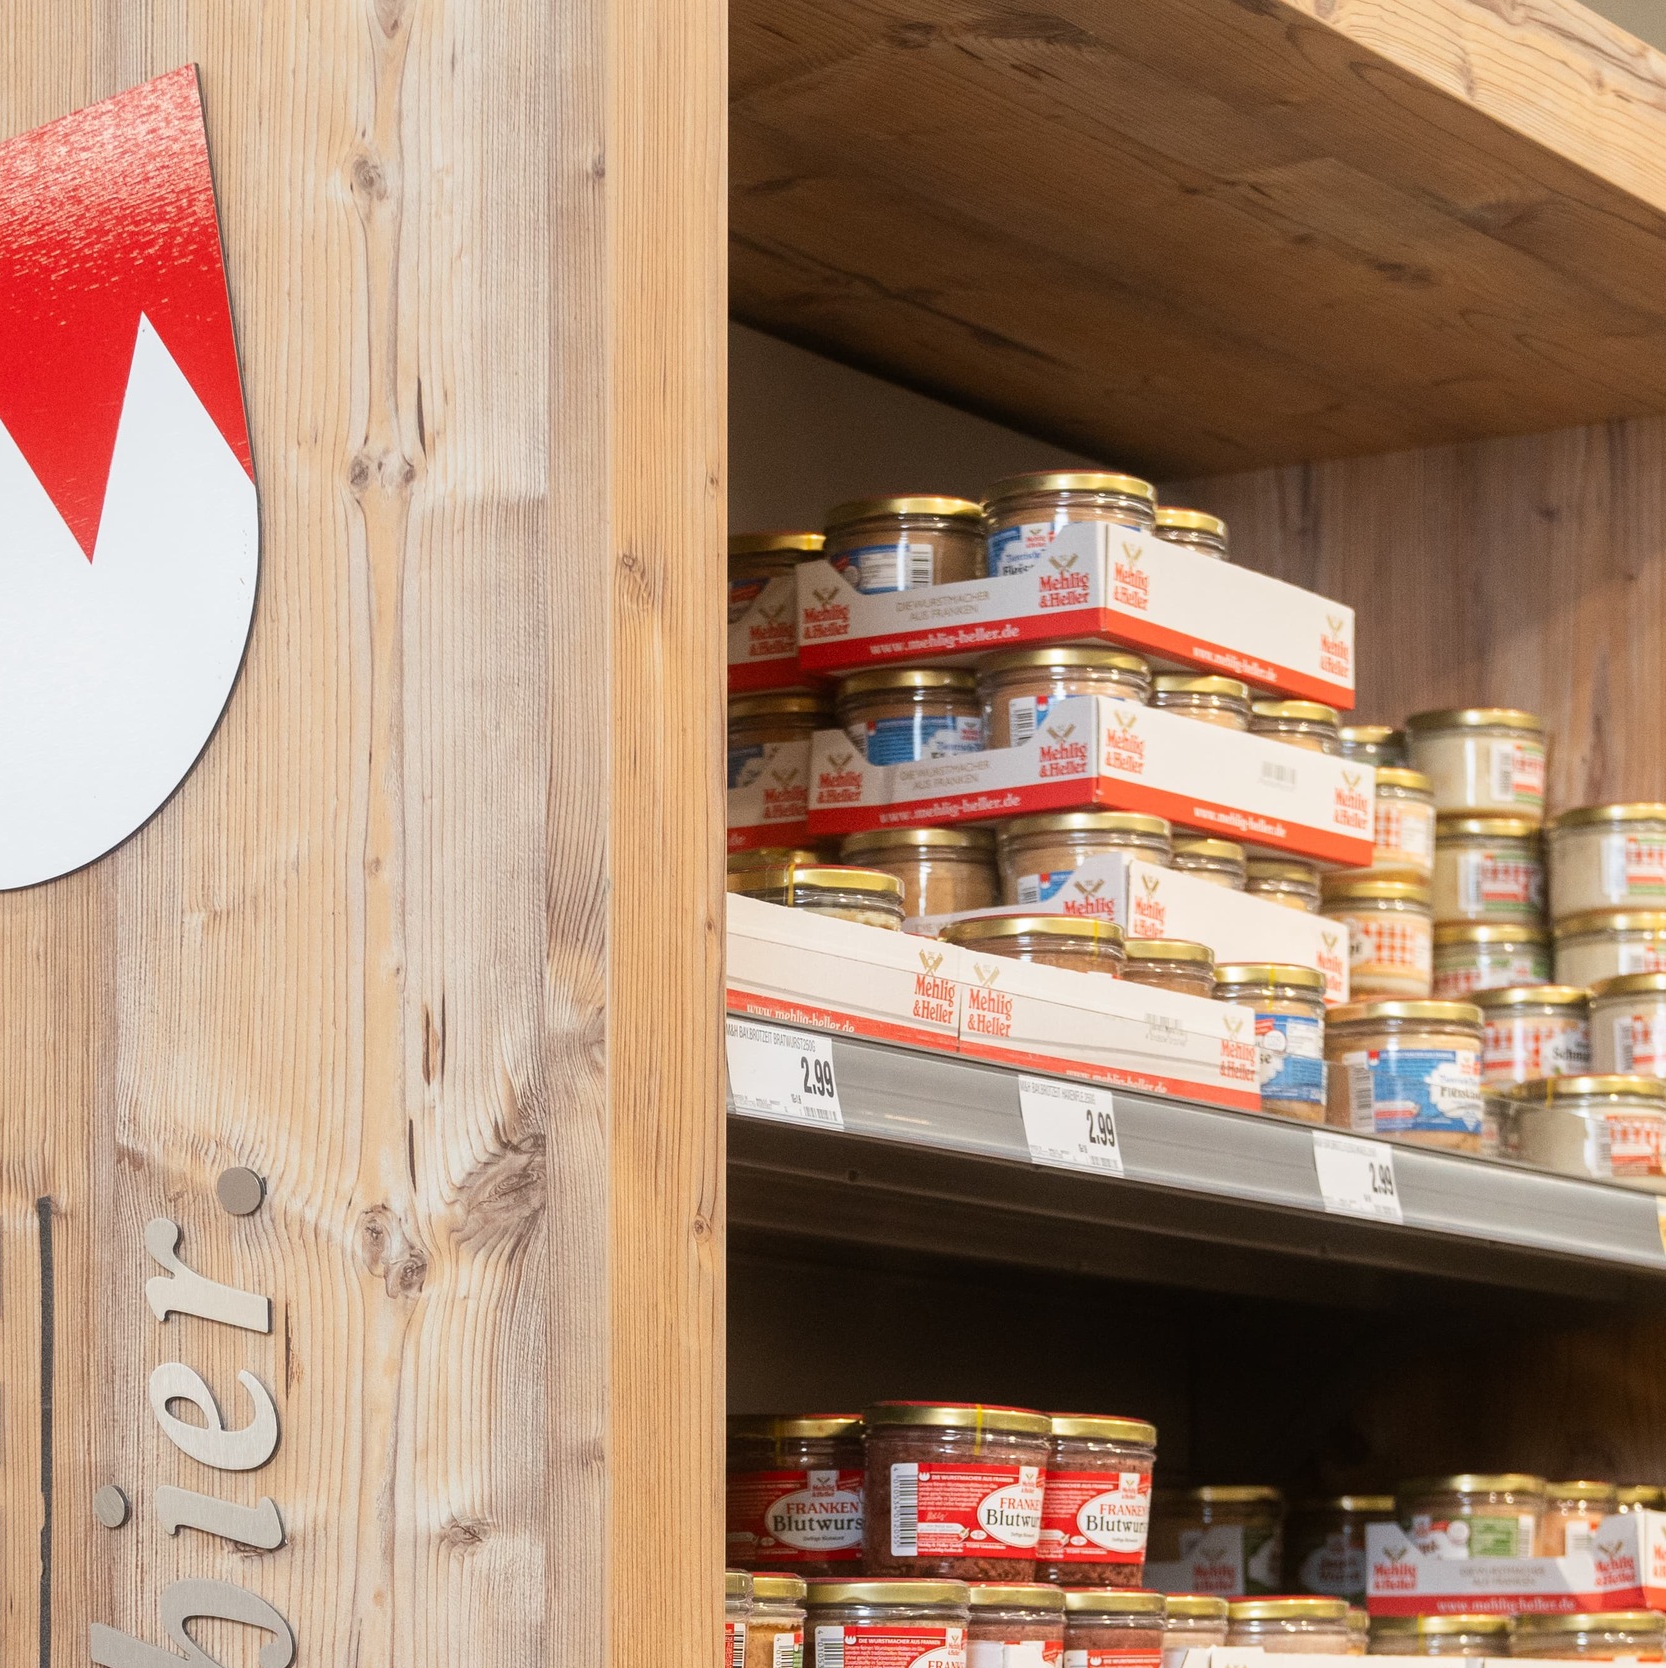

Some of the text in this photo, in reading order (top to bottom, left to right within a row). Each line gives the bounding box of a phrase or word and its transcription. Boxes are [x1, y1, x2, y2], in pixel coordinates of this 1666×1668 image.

[870, 624, 1020, 656] www.mehlig-heller.de
[879, 794, 1021, 824] www.mehlig-heller.de
[1063, 896, 1116, 919] Mehlig
[914, 974, 956, 1003] Mehlig
[912, 1000, 954, 1024] &Heller
[968, 989, 1013, 1020] Mehlig
[967, 1013, 1011, 1038] &Heller
[800, 1056, 834, 1098] 2.99
[1086, 1109, 1115, 1147] 2.99
[787, 1503, 859, 1514] FRANKEN
[1437, 1598, 1576, 1616] www.mehlig-heller.de
